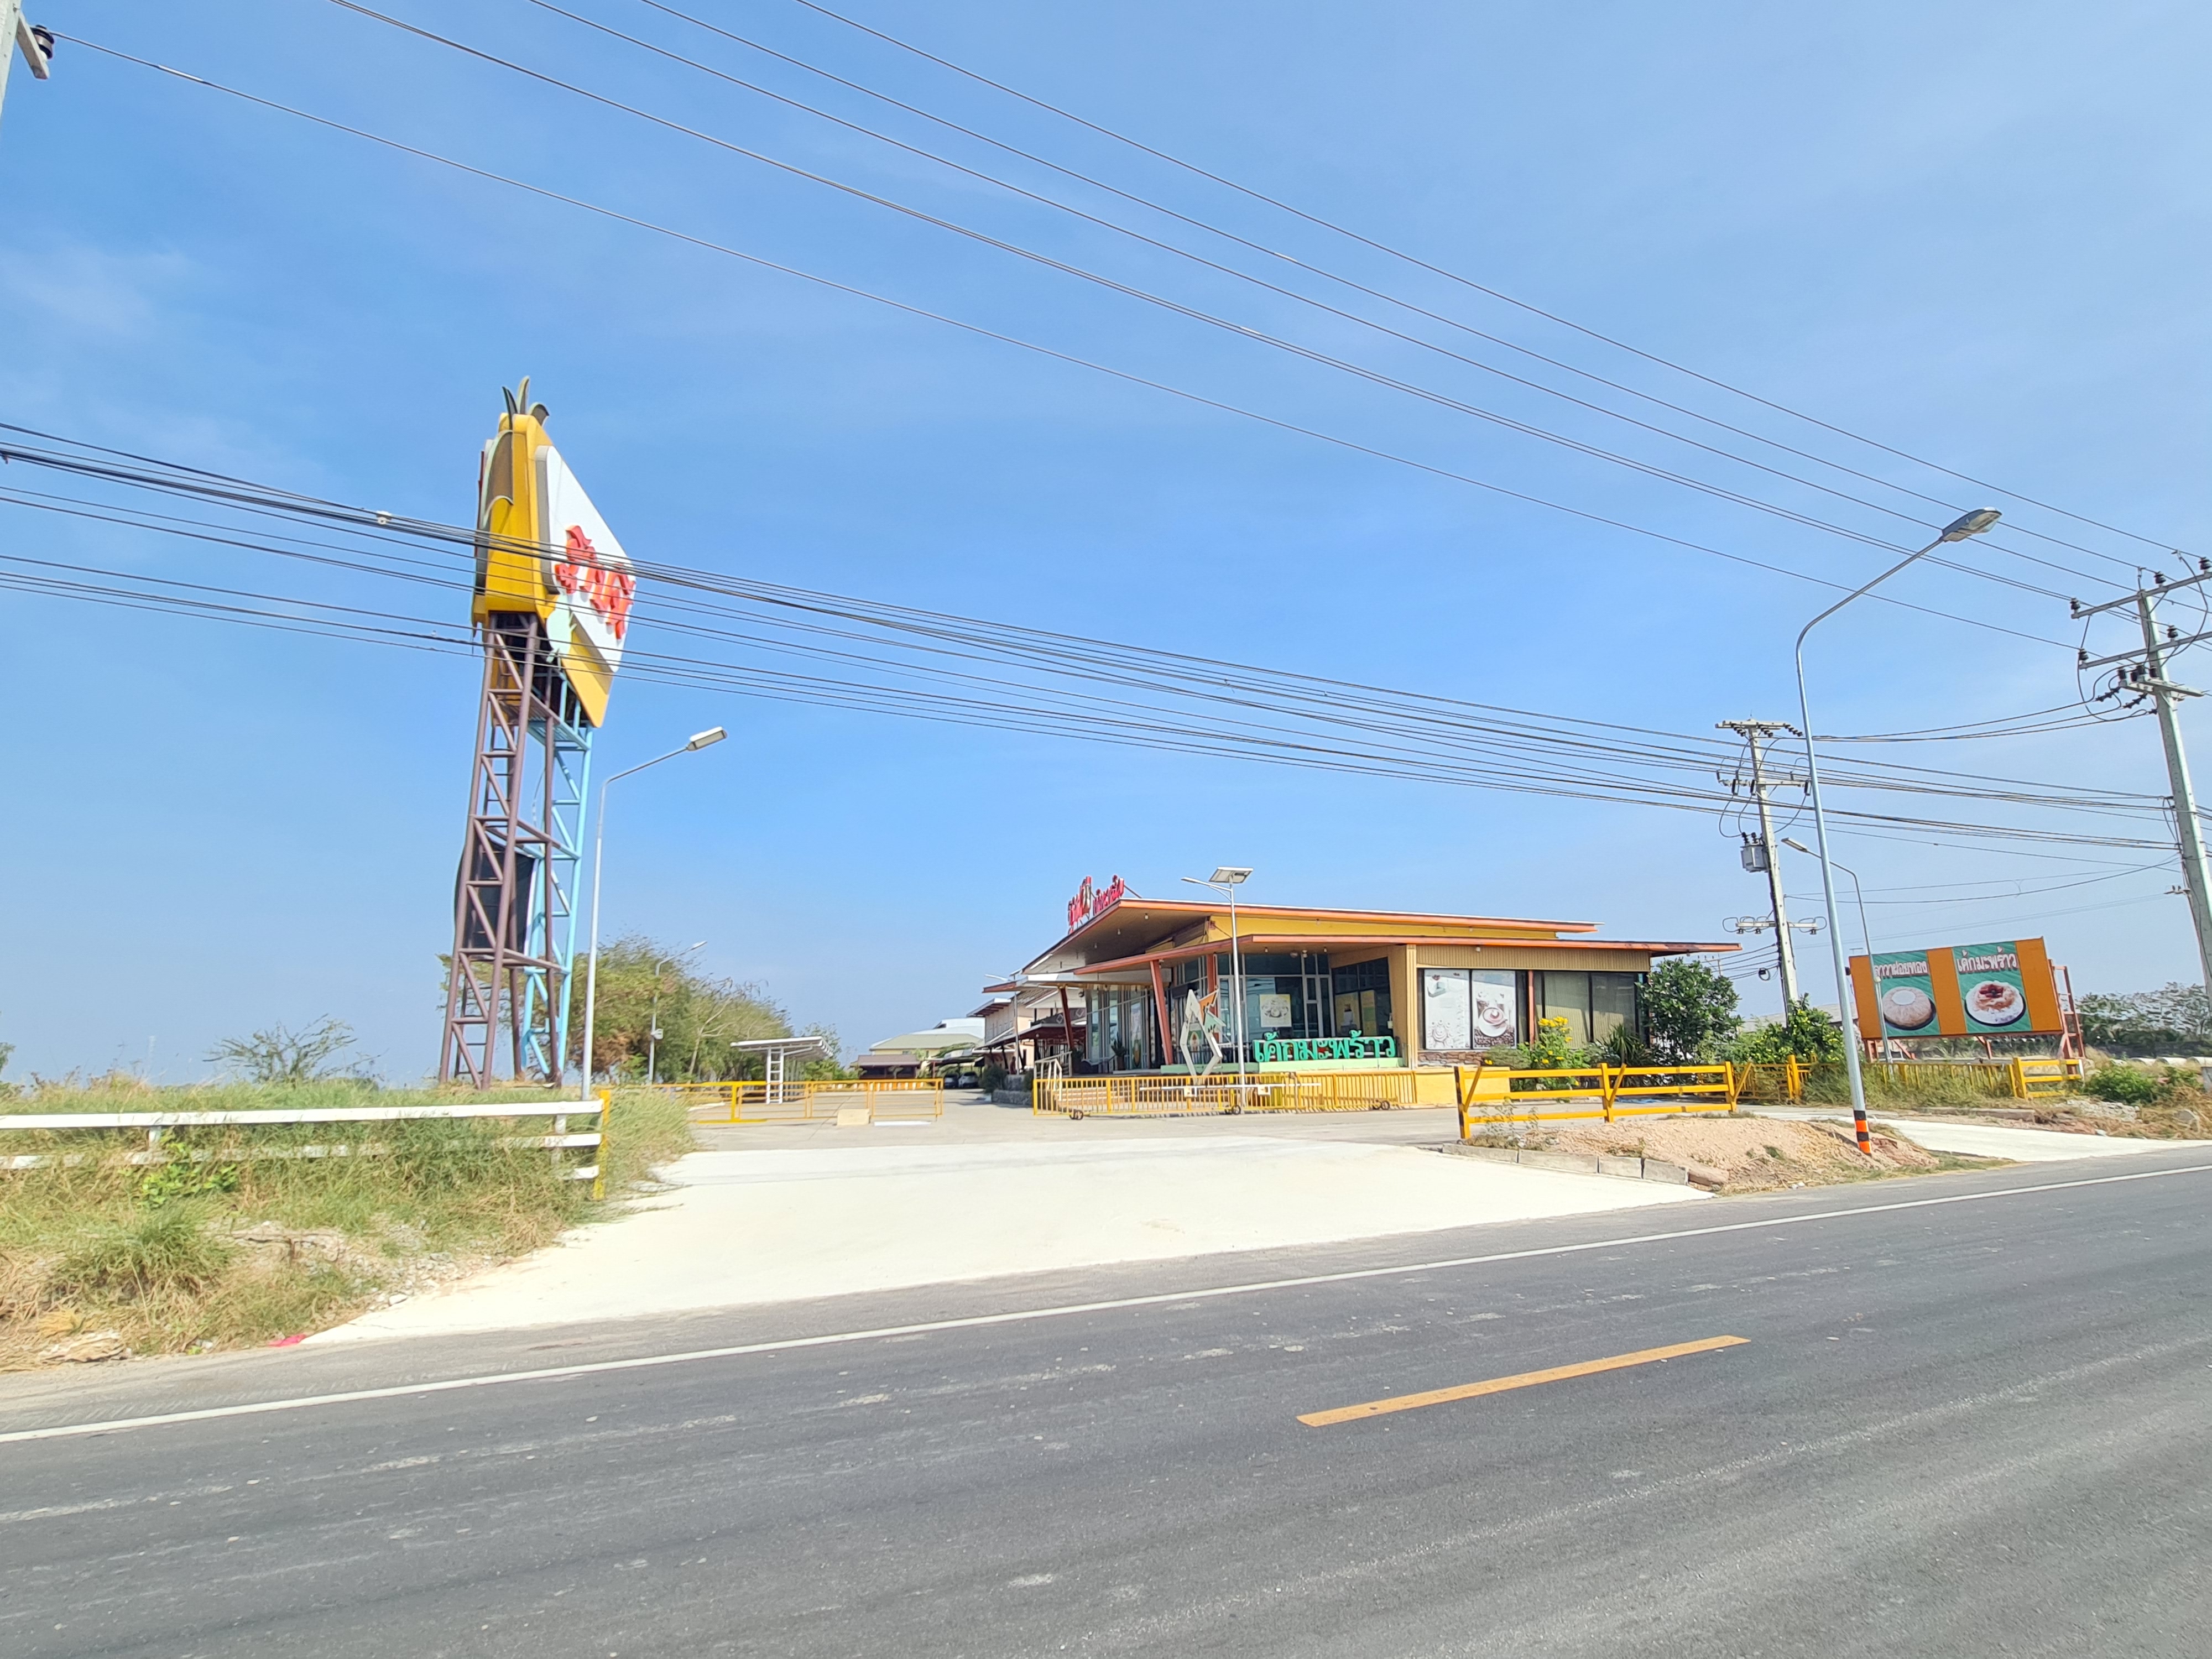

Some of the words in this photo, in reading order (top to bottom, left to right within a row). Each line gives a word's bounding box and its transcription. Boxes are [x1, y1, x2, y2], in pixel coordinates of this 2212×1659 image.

[1956, 946, 2018, 972] เค้กมะพร้าว
[1253, 1029, 1396, 1062] เค้กมะพร้าว
